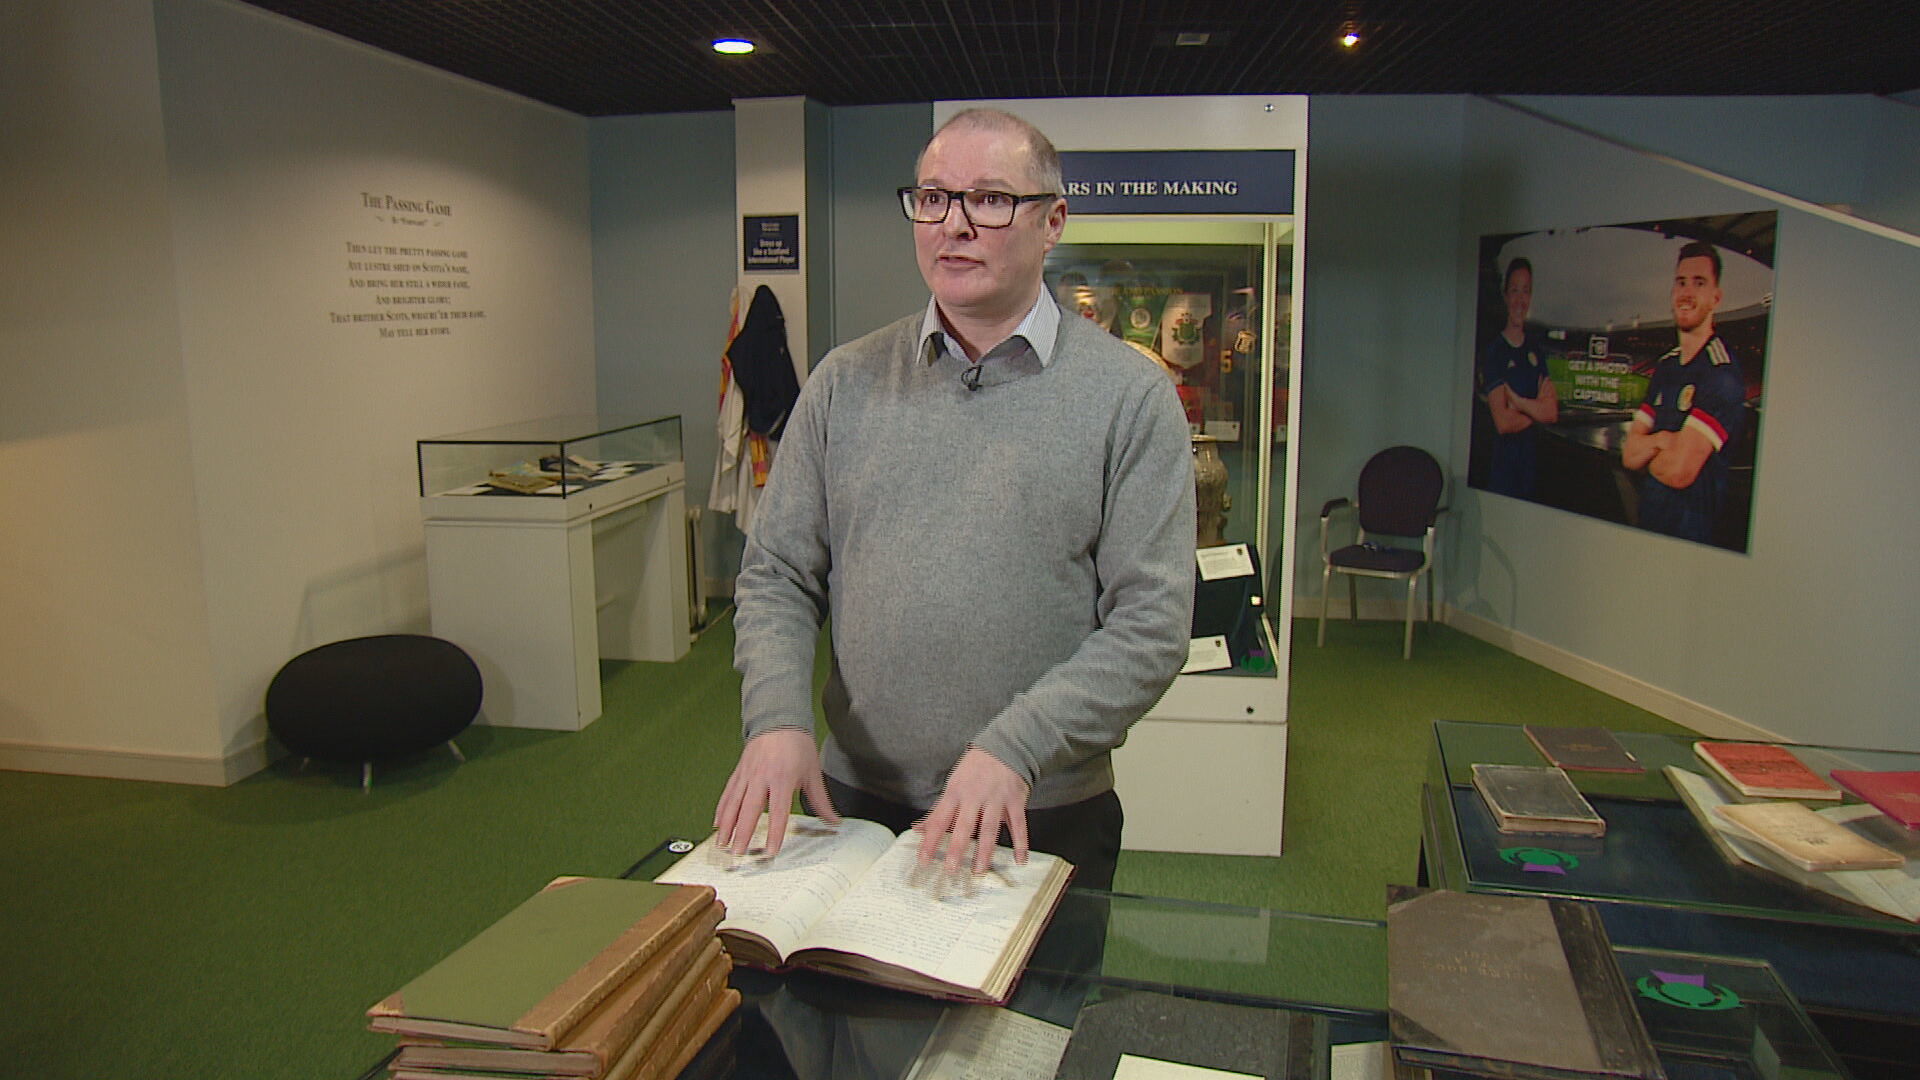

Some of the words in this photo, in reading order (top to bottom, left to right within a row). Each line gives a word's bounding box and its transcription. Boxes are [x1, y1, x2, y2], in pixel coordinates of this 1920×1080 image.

[1096, 182, 1115, 196] IN
[1120, 182, 1158, 196] THE
[1163, 181, 1238, 195] MAKING
[361, 192, 382, 208] THE
[385, 195, 424, 212] PASSING
[425, 200, 452, 216] GAME
[368, 244, 383, 255] LET
[384, 245, 398, 256] THE
[349, 278, 366, 289] AND
[376, 294, 391, 305] AND
[329, 312, 350, 324] THAT
[1568, 360, 1586, 371] GET
[1587, 360, 1594, 371] A
[1595, 361, 1629, 374] PHOTO
[1575, 375, 1600, 387] WITH
[1600, 376, 1620, 389] THE
[1573, 389, 1619, 404] CAPTAINS
